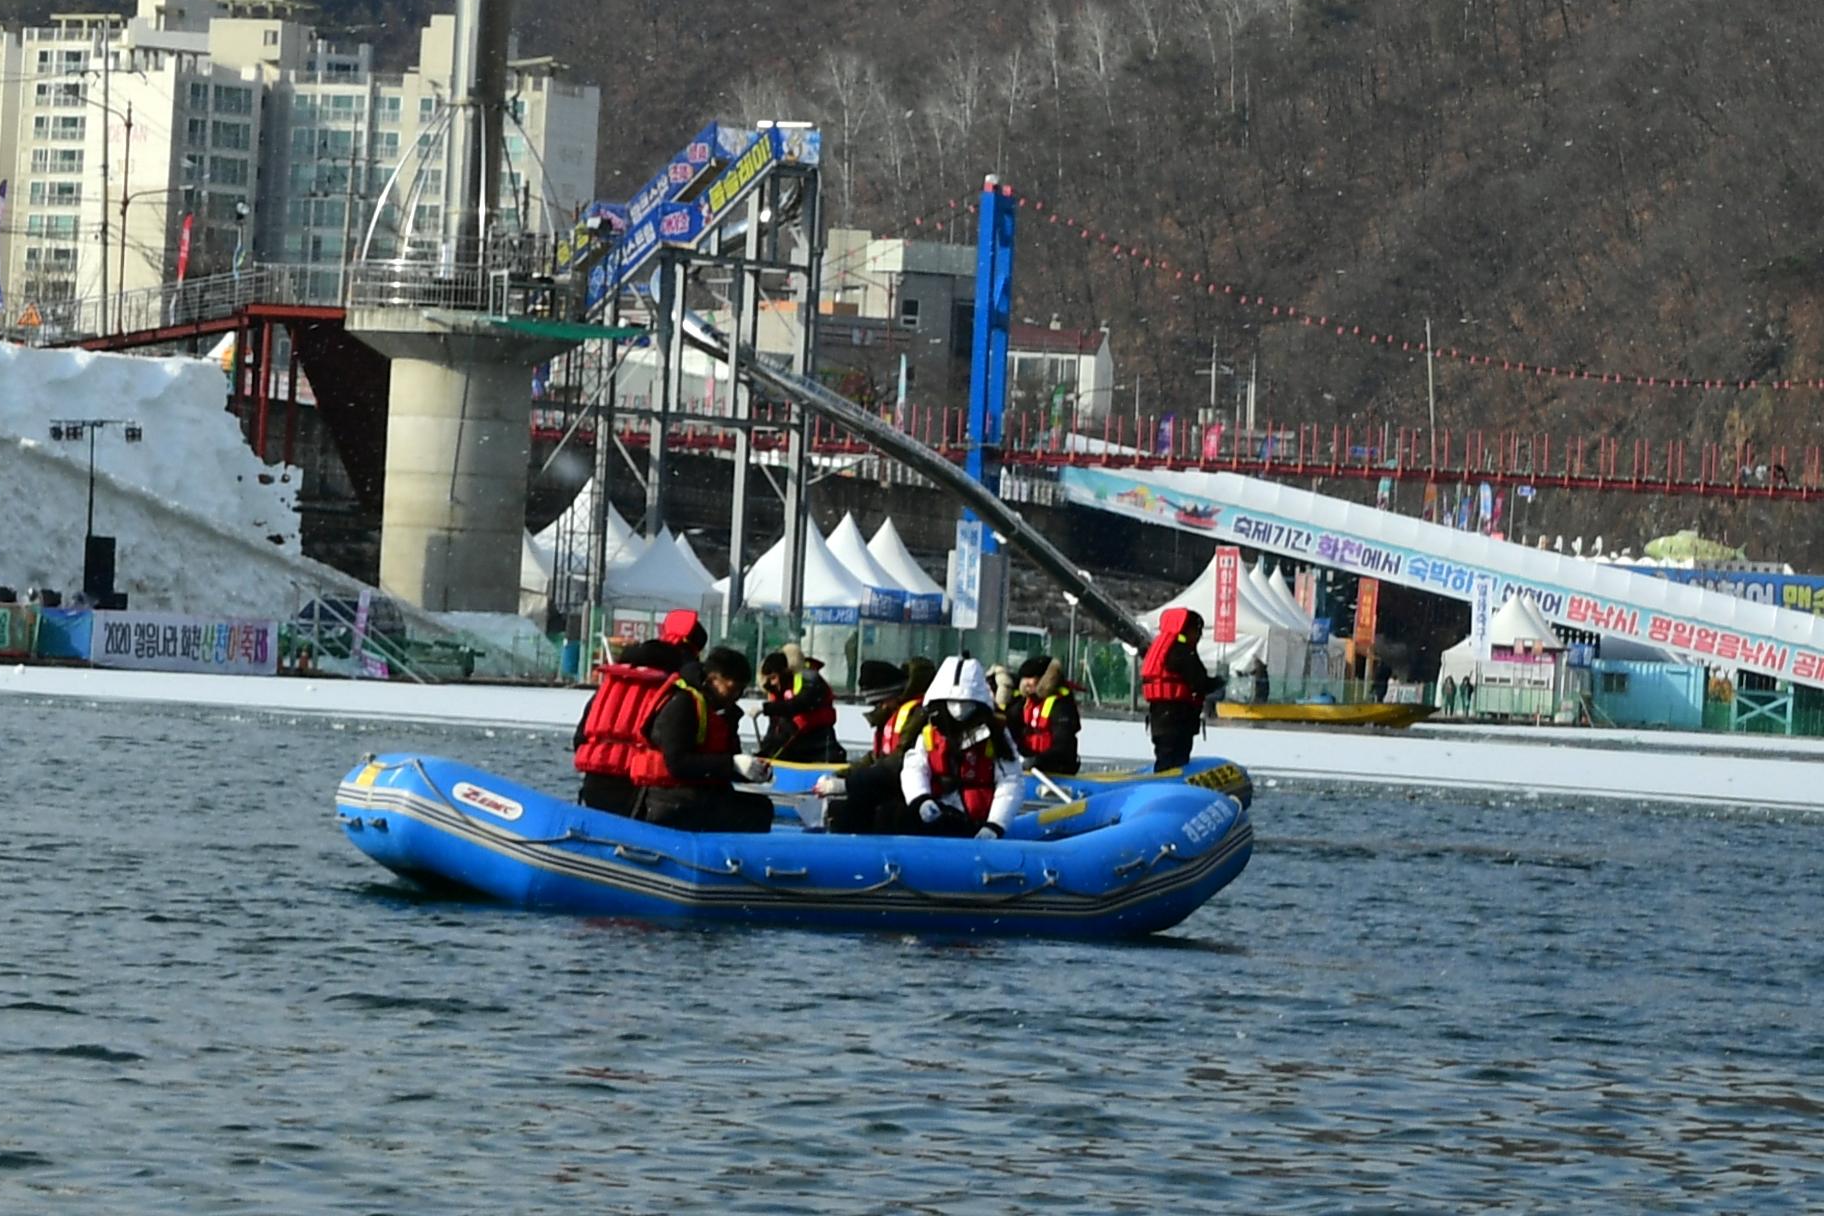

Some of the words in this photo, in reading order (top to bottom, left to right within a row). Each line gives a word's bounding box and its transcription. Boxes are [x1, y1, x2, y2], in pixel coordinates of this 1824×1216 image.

[1233, 515, 1312, 553] 축제기간
[1316, 534, 1402, 575] 화천에서
[104, 622, 132, 655] 2020
[134, 622, 177, 659] 얼음나라
